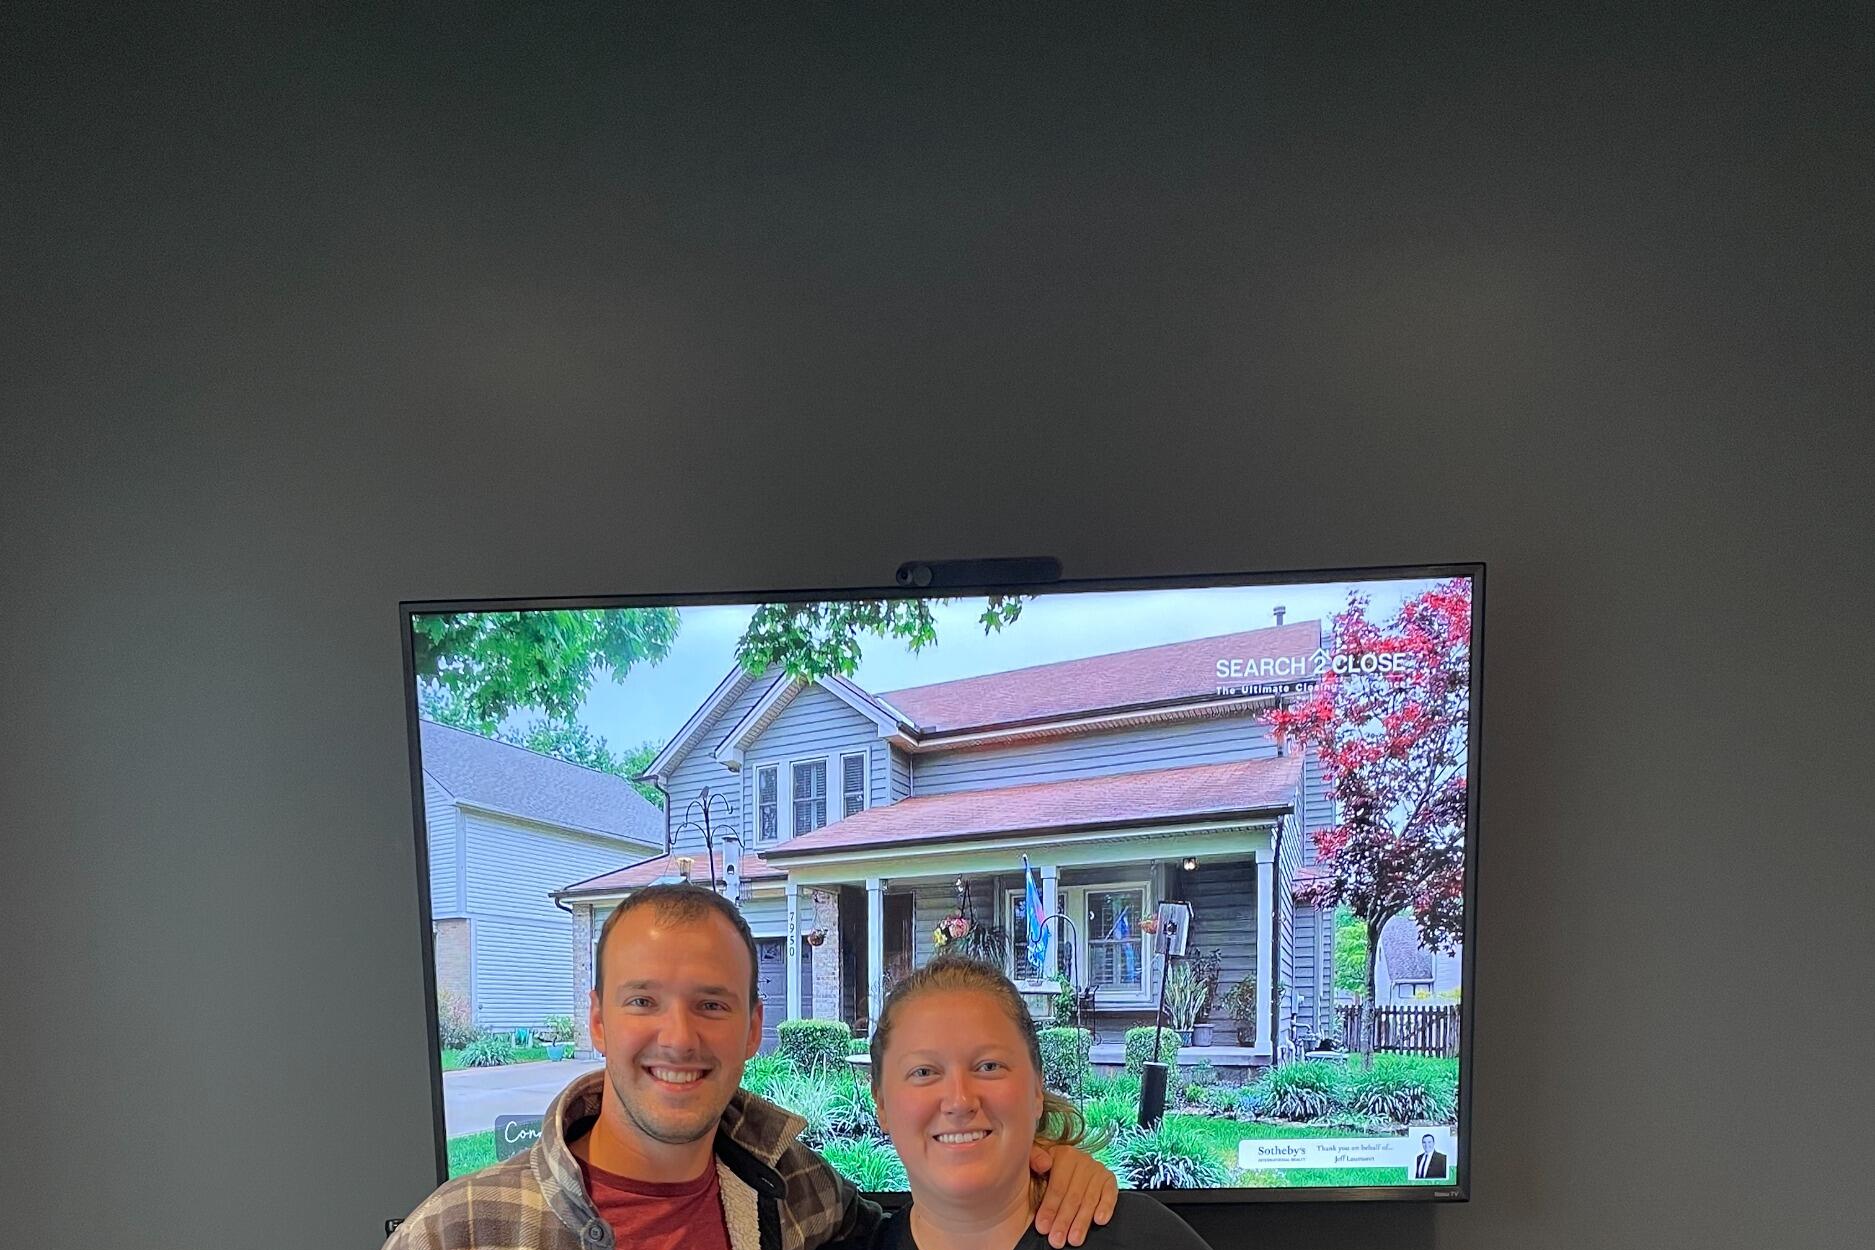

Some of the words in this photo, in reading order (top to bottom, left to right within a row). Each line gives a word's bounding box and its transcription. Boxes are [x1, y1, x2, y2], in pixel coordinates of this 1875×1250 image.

[1216, 657, 1305, 677] SEARCH
[1331, 652, 1407, 674] CLOSE
[1216, 686, 1236, 696] The
[1241, 683, 1290, 694] Ultimate
[1258, 1145, 1306, 1157] Sotheby's
